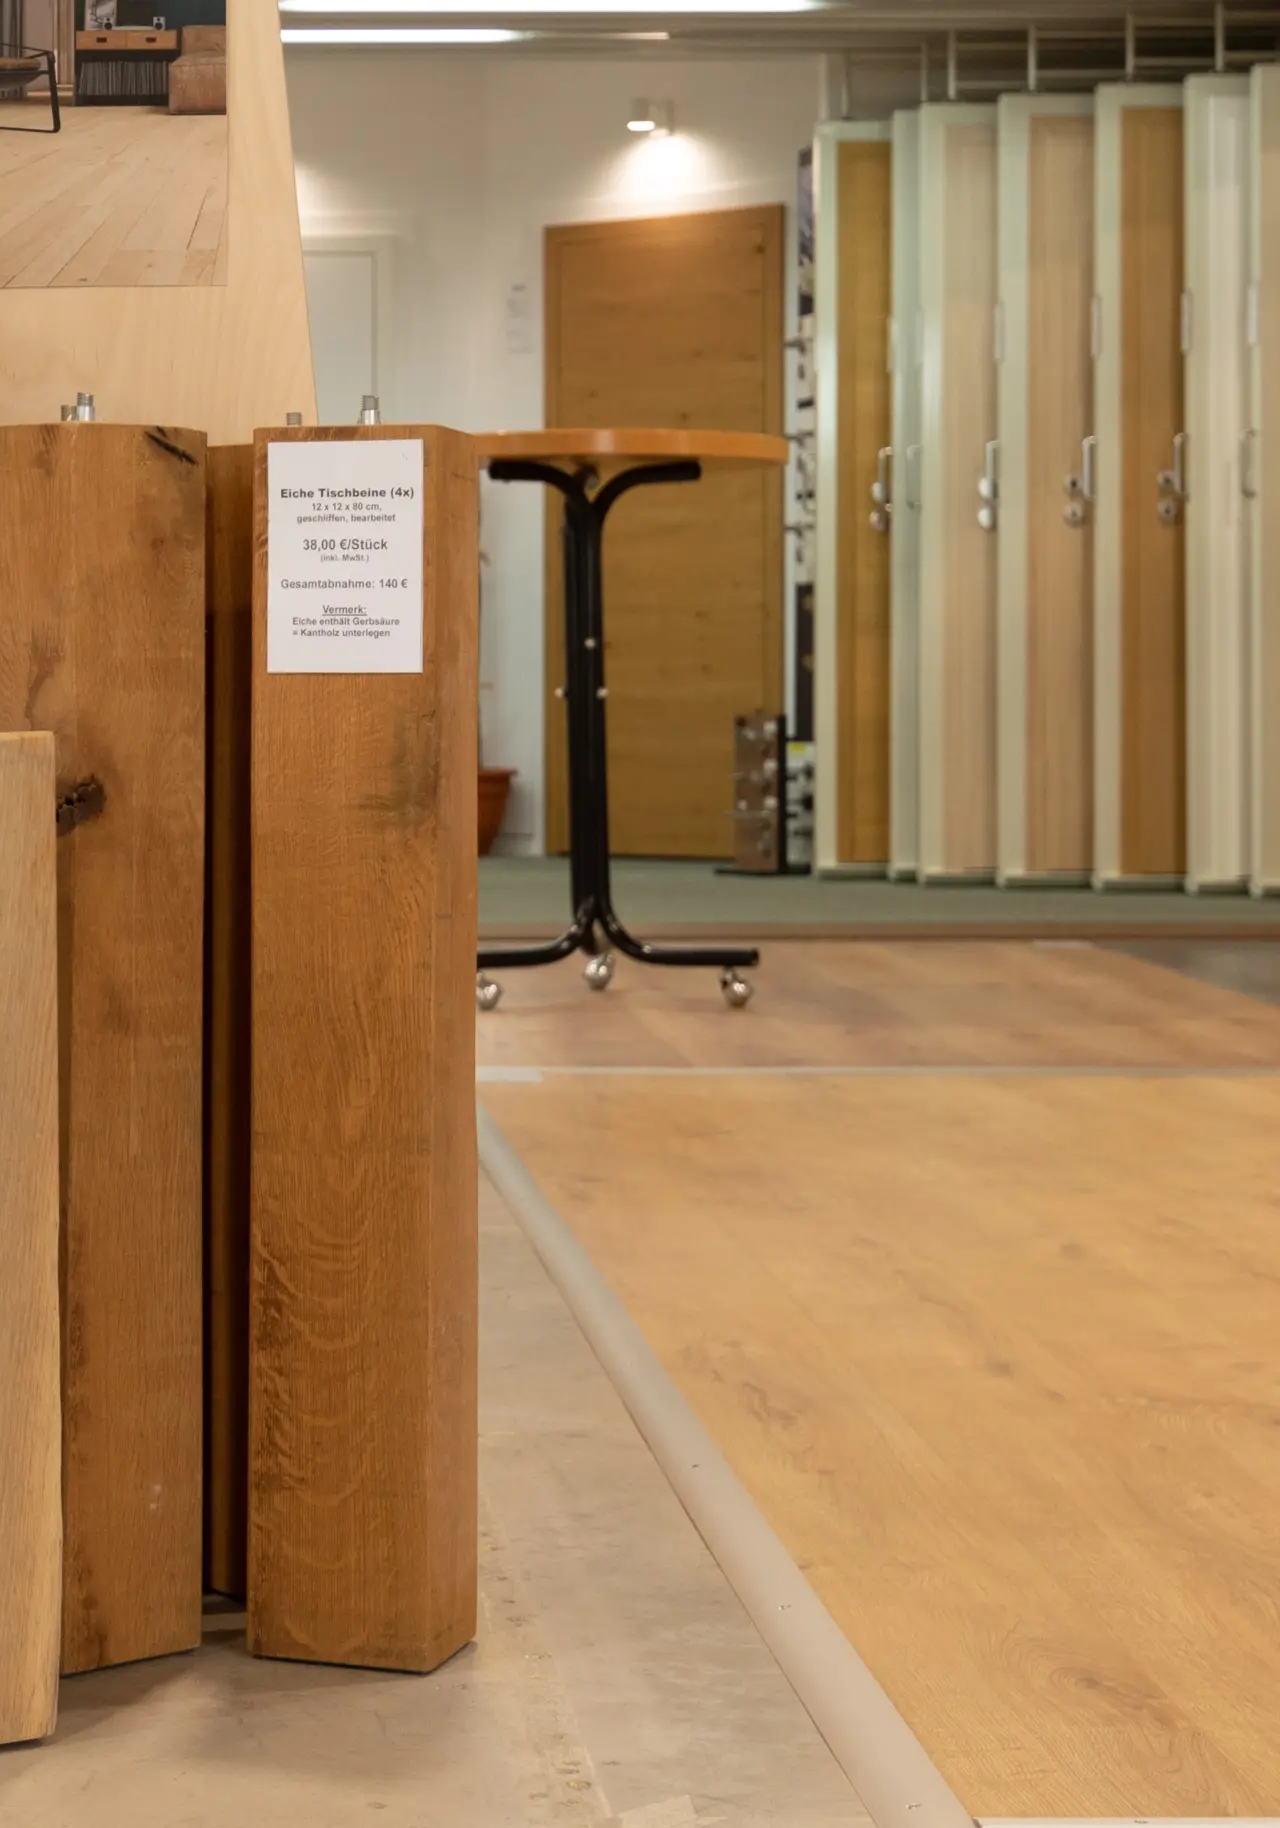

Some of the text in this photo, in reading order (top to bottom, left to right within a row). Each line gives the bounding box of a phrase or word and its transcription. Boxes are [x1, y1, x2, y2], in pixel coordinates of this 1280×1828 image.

[280, 487, 414, 499] Eiche Tischbeine (4x)
[312, 502, 322, 511] 12
[333, 502, 342, 511] 12
[352, 502, 363, 511] 80
[366, 503, 382, 512] cm,
[296, 513, 396, 524] geschliffen, bearbeitet
[303, 538, 388, 552] 38,00 €/Stück
[320, 554, 369, 562] (inkl. MwSt.)
[280, 578, 408, 589] Gesamtabnahme: 140 €
[322, 605, 368, 616] Vermerk:
[292, 617, 400, 625] Eiche enthält Gerbsäure
[300, 628, 340, 637] Kantholz
[342, 629, 390, 639] unterlegen
